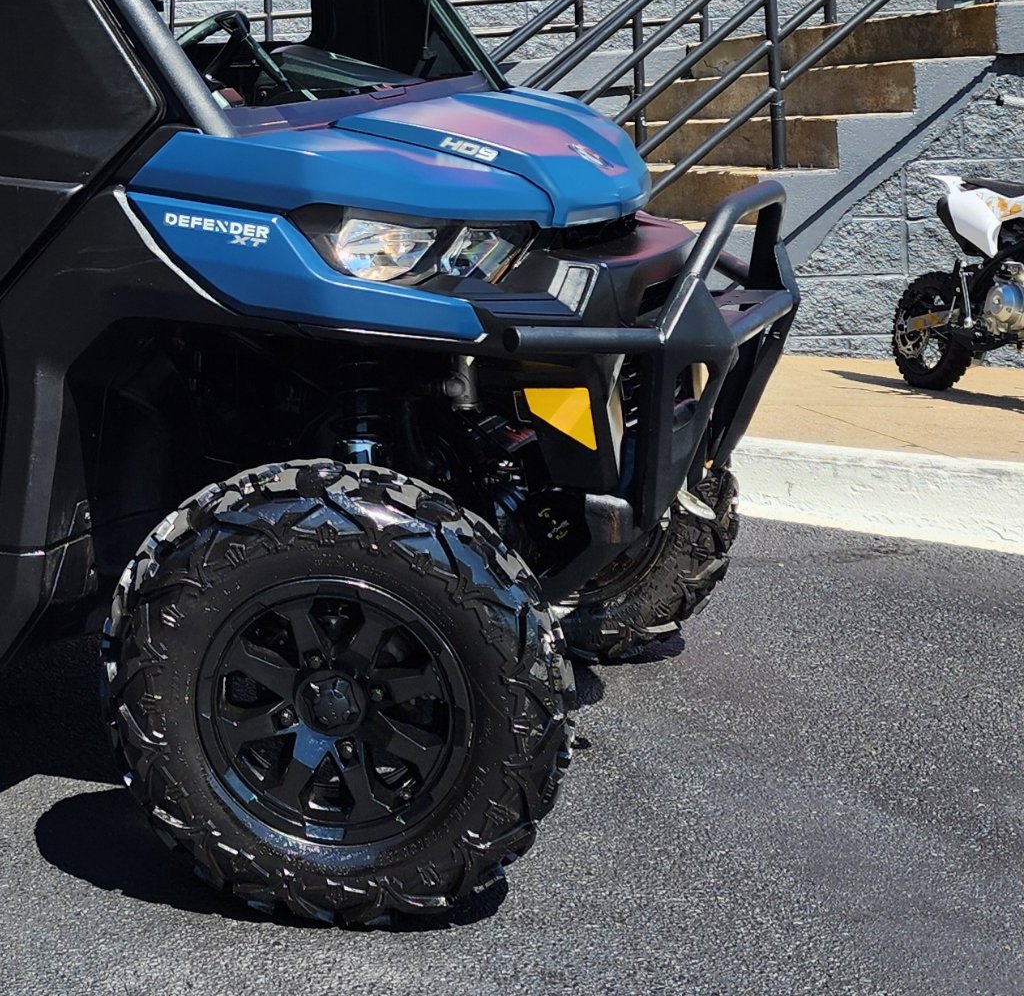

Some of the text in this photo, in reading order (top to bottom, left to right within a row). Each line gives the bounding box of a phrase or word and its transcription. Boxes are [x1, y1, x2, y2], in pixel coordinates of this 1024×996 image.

[439, 136, 499, 162] HD9
[165, 212, 270, 239] DEFENDER
[230, 234, 268, 248] XT
